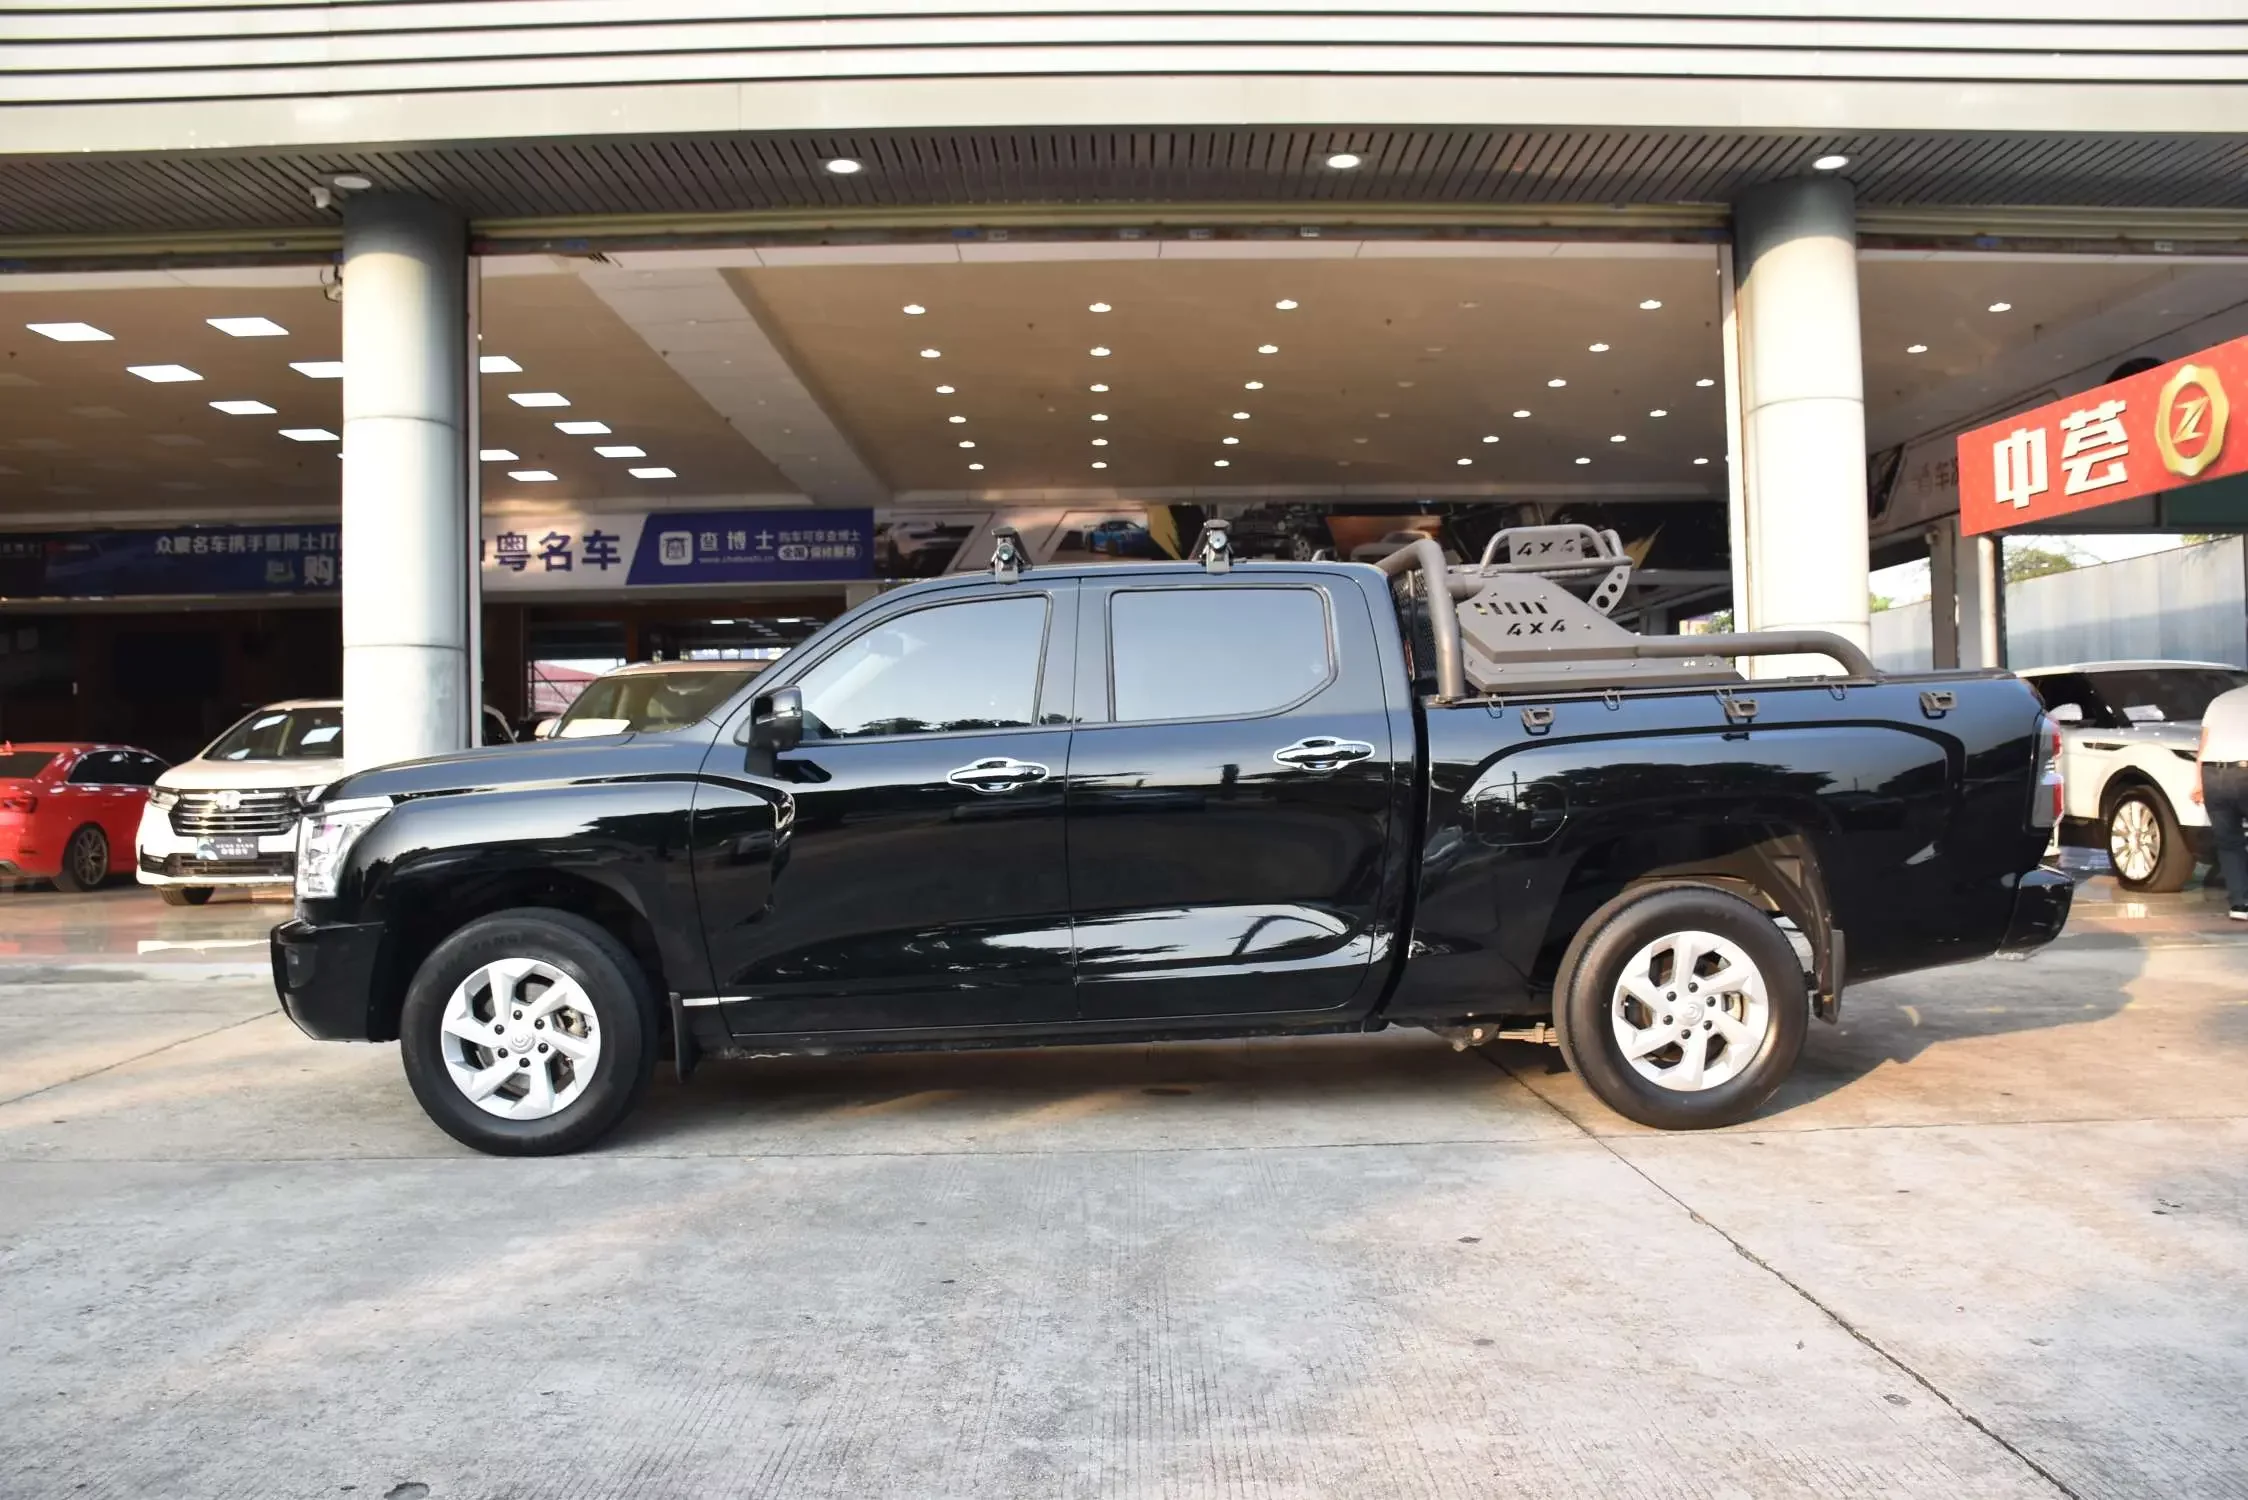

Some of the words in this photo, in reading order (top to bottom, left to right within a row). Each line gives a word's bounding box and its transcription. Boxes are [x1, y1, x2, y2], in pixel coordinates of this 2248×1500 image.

[1993, 399, 2129, 510] 中荟
[304, 554, 342, 586] 购
[480, 529, 621, 572] 粤名车
